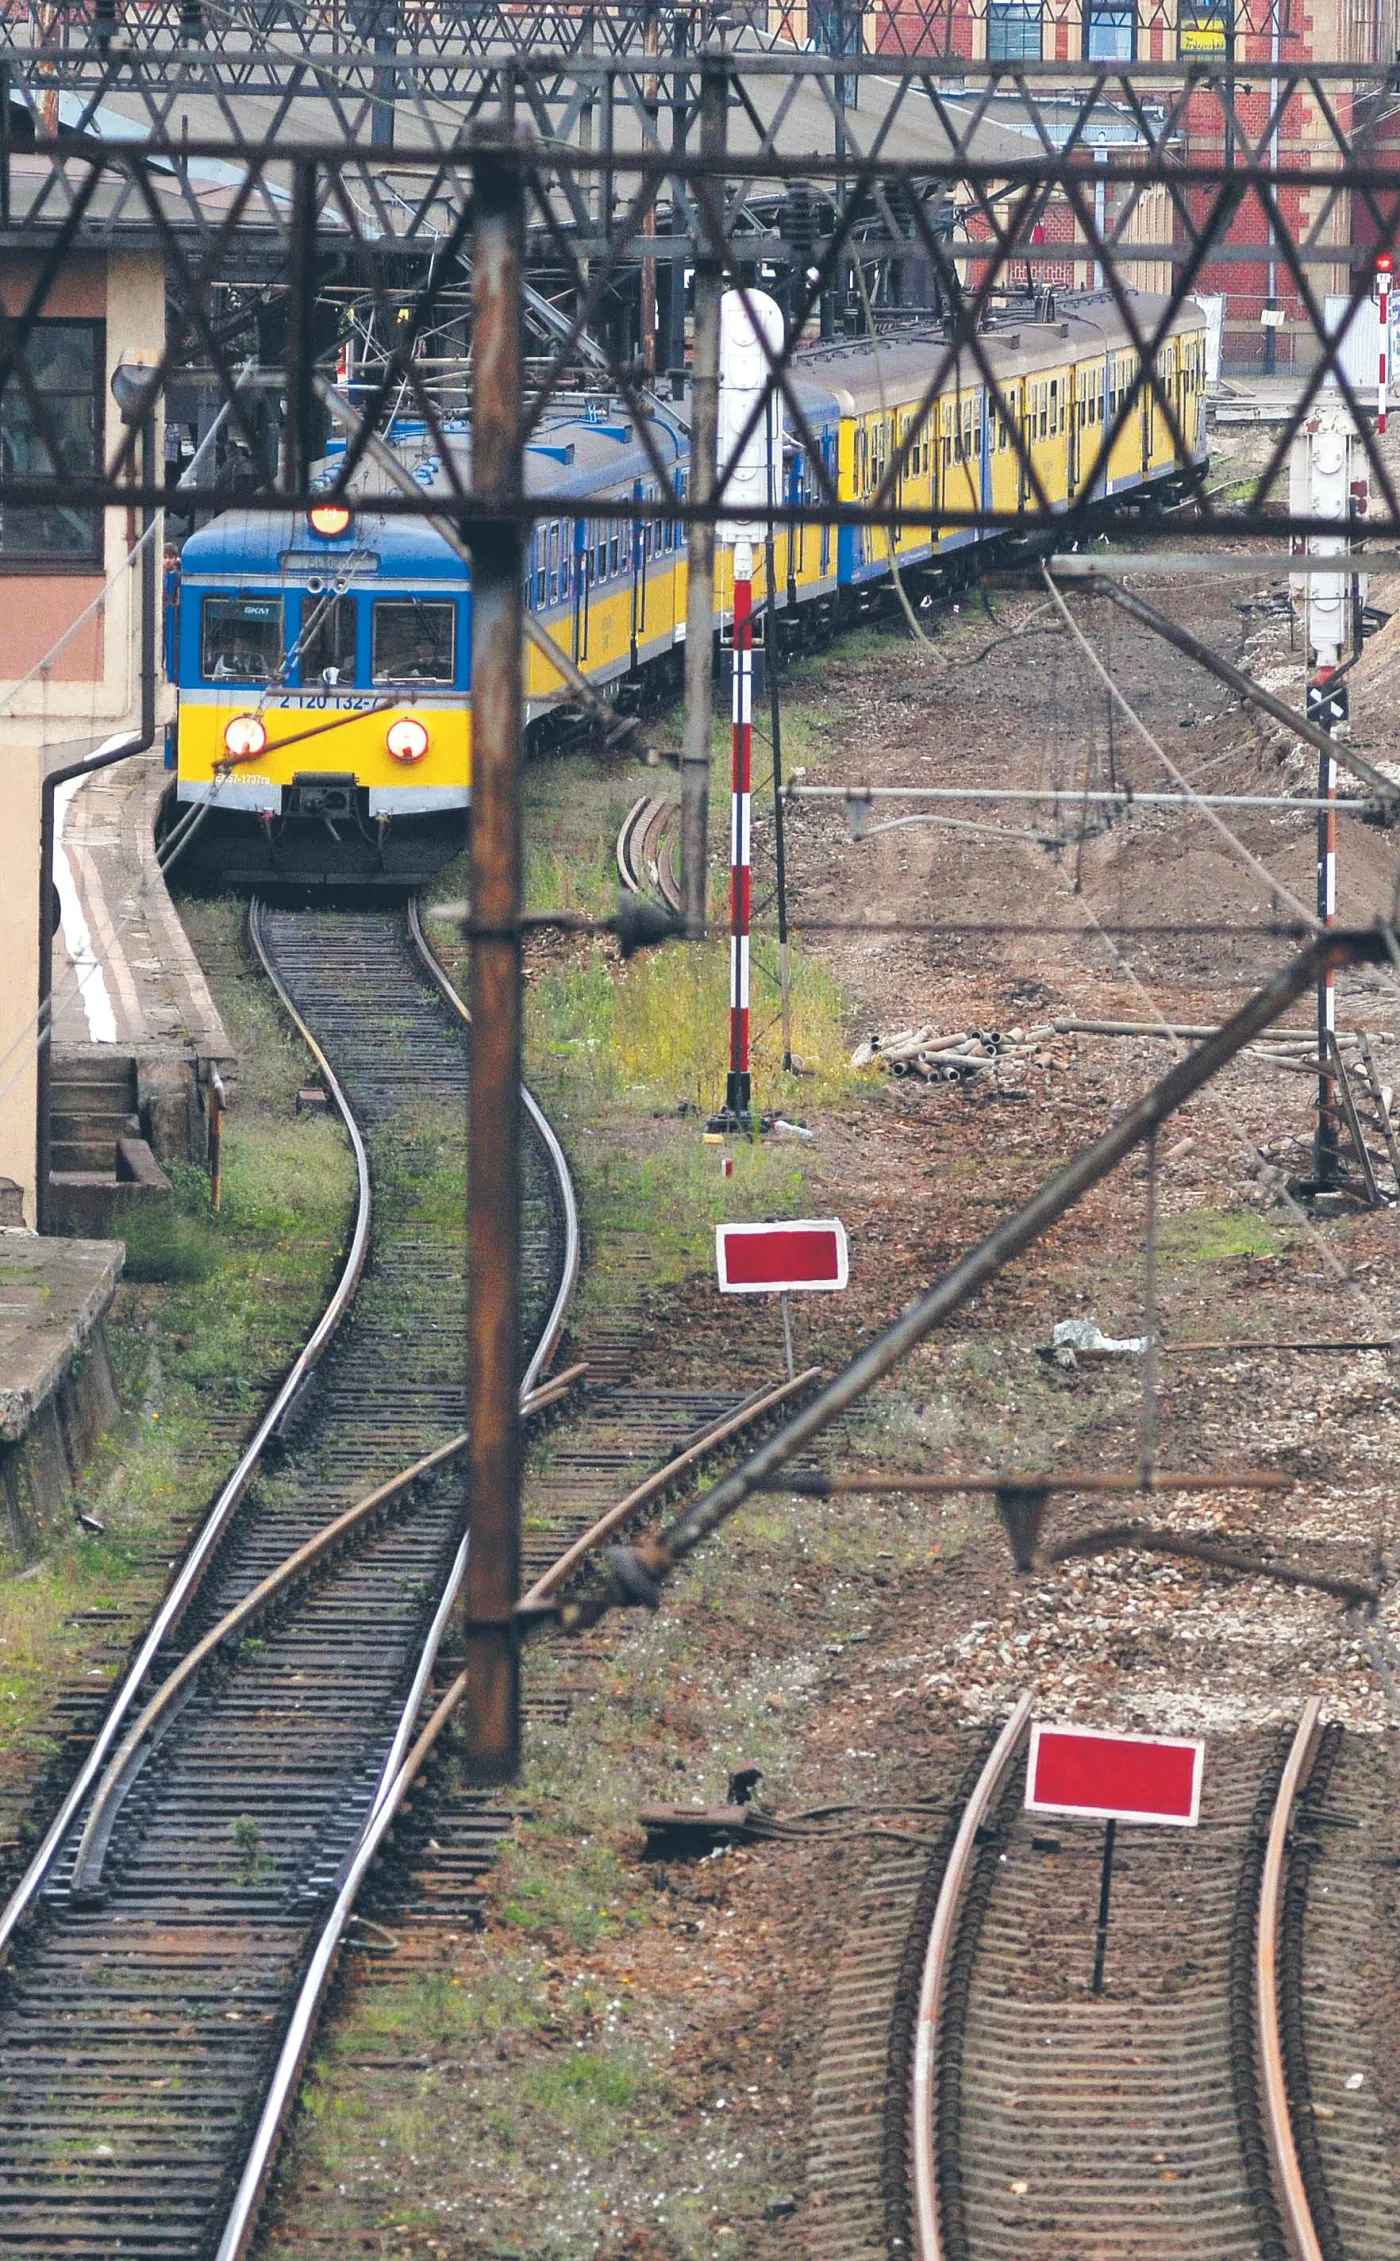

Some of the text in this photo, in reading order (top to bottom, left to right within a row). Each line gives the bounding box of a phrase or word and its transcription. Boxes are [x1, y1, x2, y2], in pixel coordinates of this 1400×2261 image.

[244, 606, 270, 615] SKM
[280, 696, 290, 709] 2
[300, 696, 327, 709] 120
